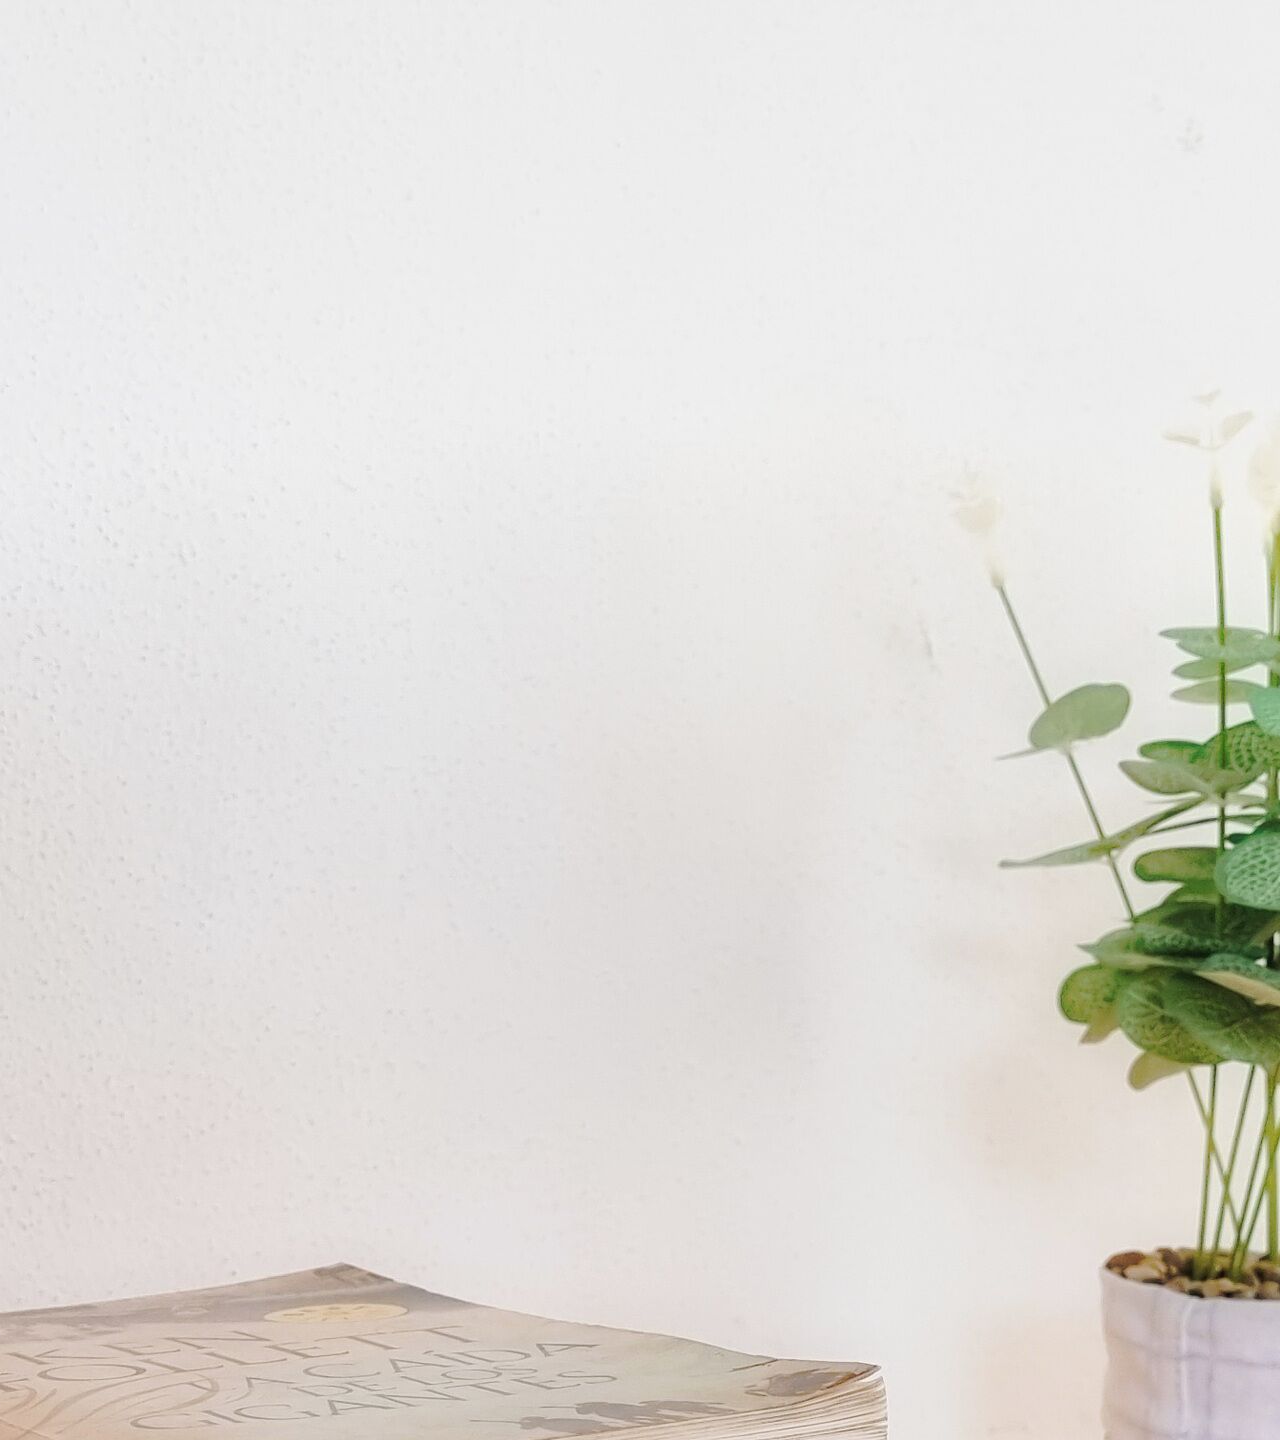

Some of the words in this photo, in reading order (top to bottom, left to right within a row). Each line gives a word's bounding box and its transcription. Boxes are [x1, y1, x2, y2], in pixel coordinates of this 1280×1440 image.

[7, 1330, 271, 1365] KEN
[302, 1342, 600, 1379] CAÍDA
[291, 1380, 397, 1398] DE
[401, 1363, 538, 1387] LOS
[130, 1370, 617, 1429] GIGANTES
